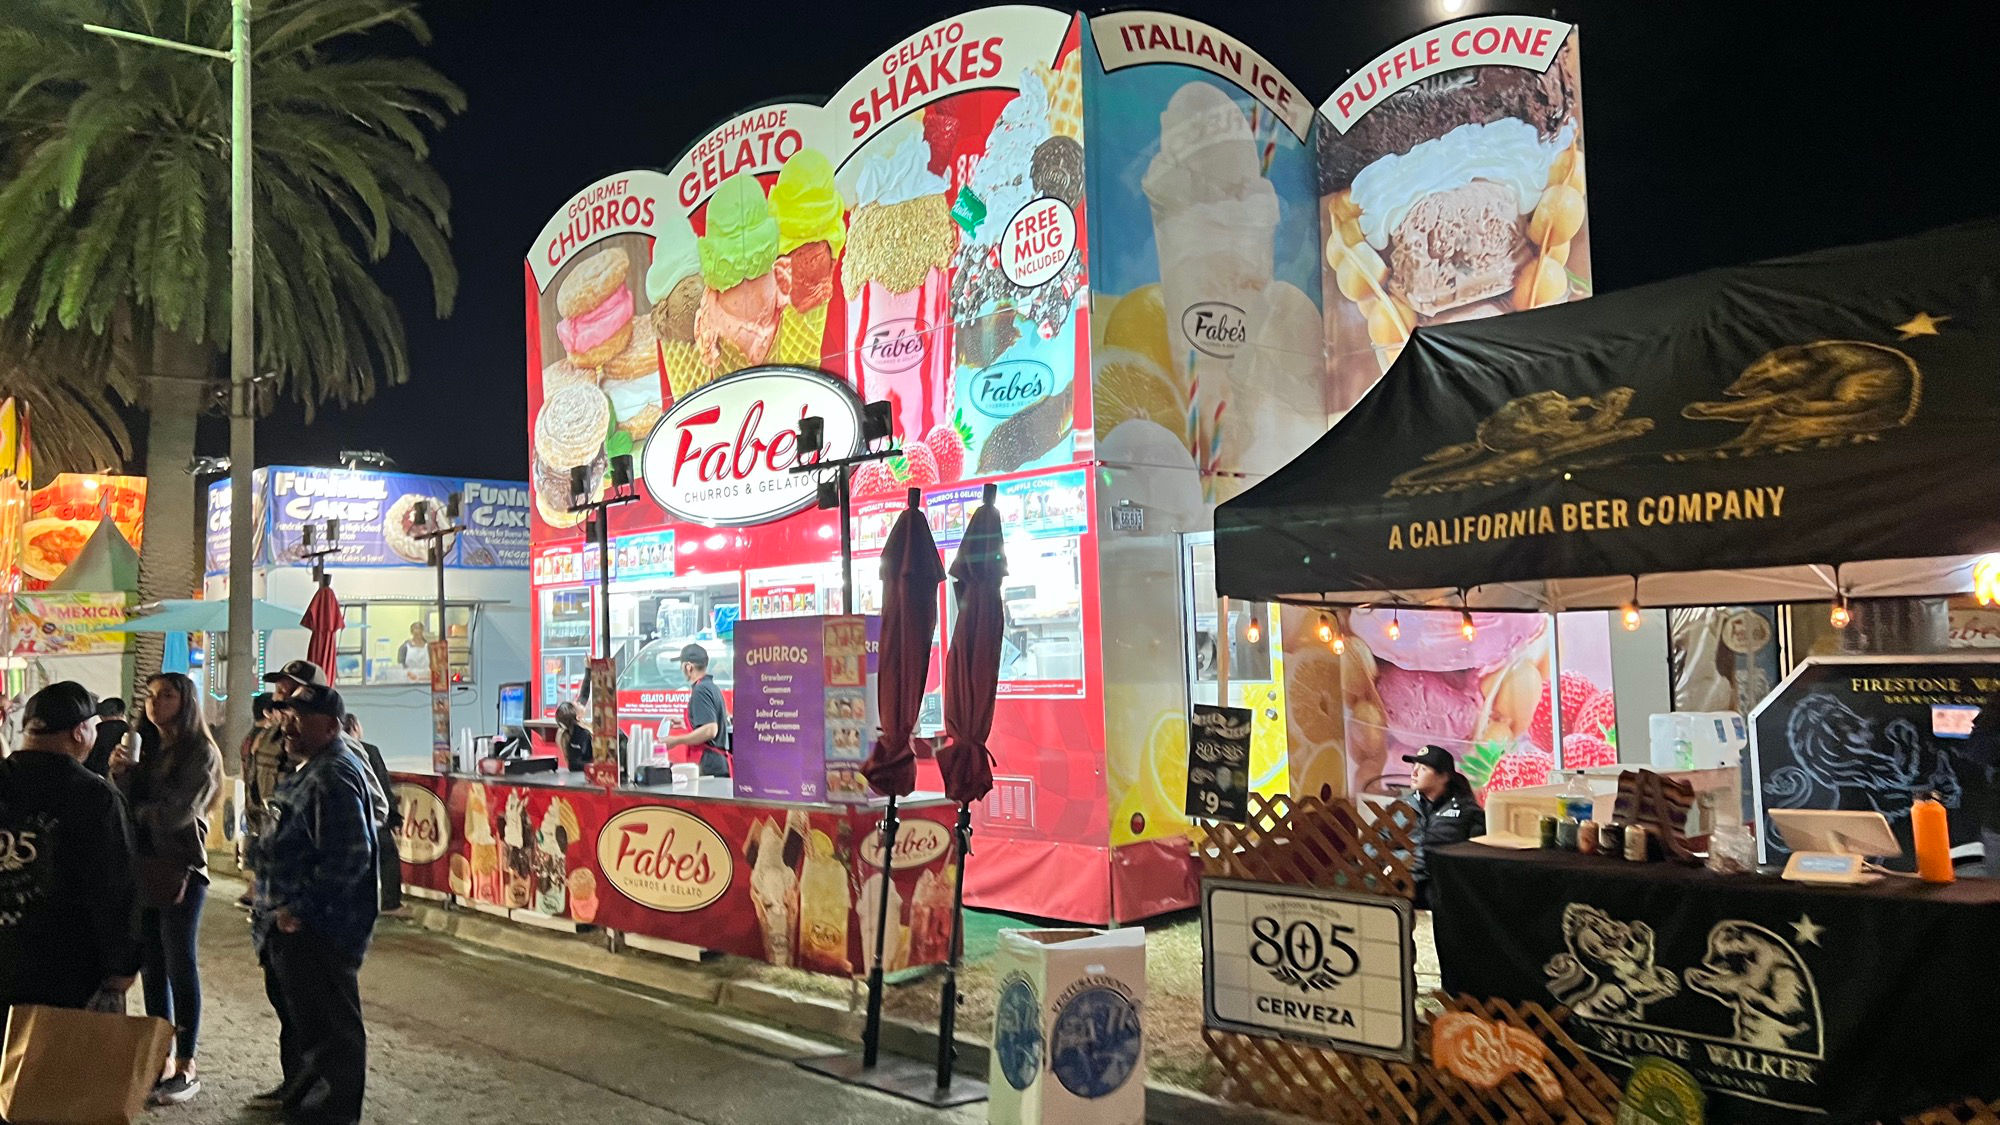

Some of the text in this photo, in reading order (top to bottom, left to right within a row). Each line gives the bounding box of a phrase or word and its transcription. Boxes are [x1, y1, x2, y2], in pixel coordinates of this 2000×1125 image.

[881, 22, 963, 75] GELATO
[1120, 24, 1292, 110] ITALIAN ICE
[1336, 25, 1554, 119] PUFFLE CONE
[850, 37, 1004, 139] SHAKES
[690, 109, 788, 164] FRESH-MADE
[679, 128, 803, 208] GELATO
[568, 178, 630, 217] GOURMET
[547, 197, 656, 267] CHURROS
[1015, 205, 1059, 241] FREE
[1014, 226, 1063, 264] MUG
[1015, 249, 1065, 280] INCLUDED
[1195, 311, 1246, 343] Fabe's
[870, 328, 924, 359] Fabe's
[981, 370, 1046, 402] Fabe's
[275, 471, 388, 499] FUNNEL
[684, 474, 809, 504] CHURROS & GELATO
[285, 497, 380, 522] CAKES
[1388, 485, 1785, 552] A CALIFORNIA BEER COMPANY
[745, 645, 808, 666] CHURROS
[761, 673, 793, 682] Strawberry
[1852, 677, 1962, 693] FIRESTONE
[641, 693, 664, 703] GELATO
[756, 709, 799, 718] Salted Caramel
[754, 722, 771, 731] Apple
[758, 733, 775, 743] Fruity
[616, 822, 716, 885] Fabe's
[623, 876, 660, 891] CHURROS
[670, 885, 703, 898] GELATO
[1250, 915, 1360, 978] 805
[1256, 996, 1356, 1028] CERVEZA
[1704, 1043, 1817, 1086] WALKER
